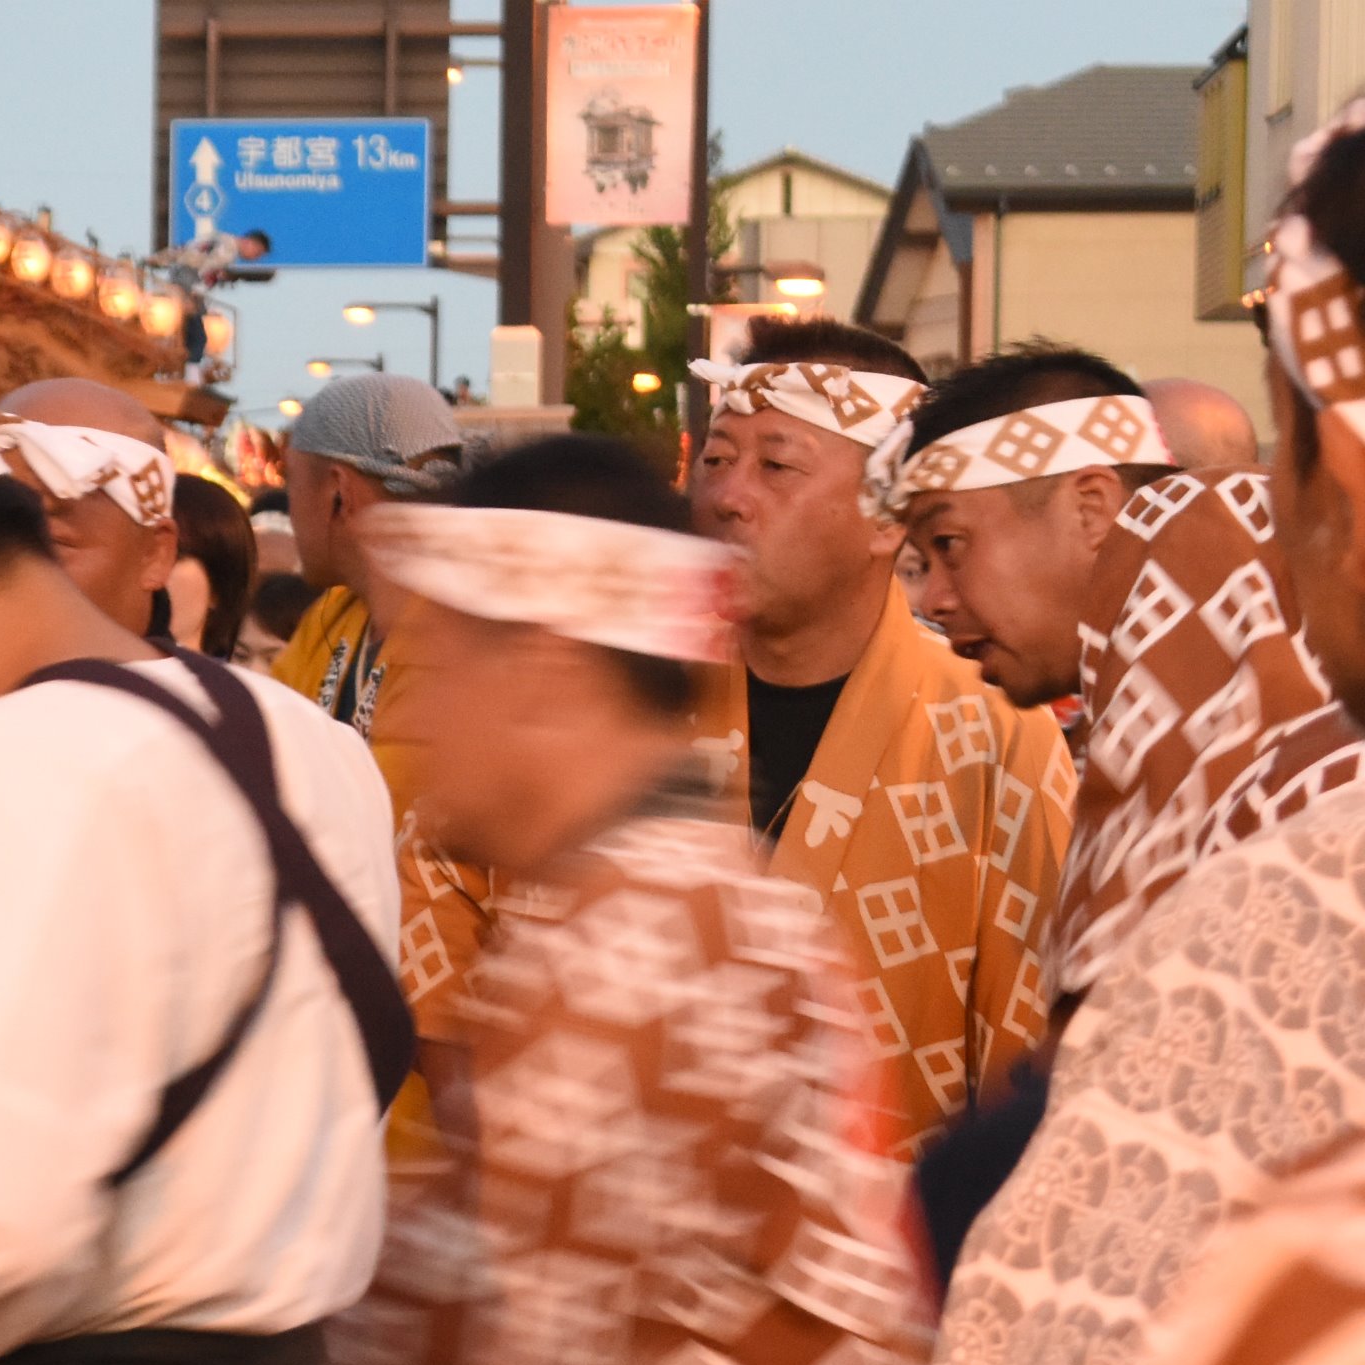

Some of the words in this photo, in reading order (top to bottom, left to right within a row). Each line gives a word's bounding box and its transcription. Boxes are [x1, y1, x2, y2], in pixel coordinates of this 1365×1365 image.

[237, 135, 339, 169] 宇都宮
[234, 171, 342, 191] Utsunomiya
[195, 188, 213, 212] 4
